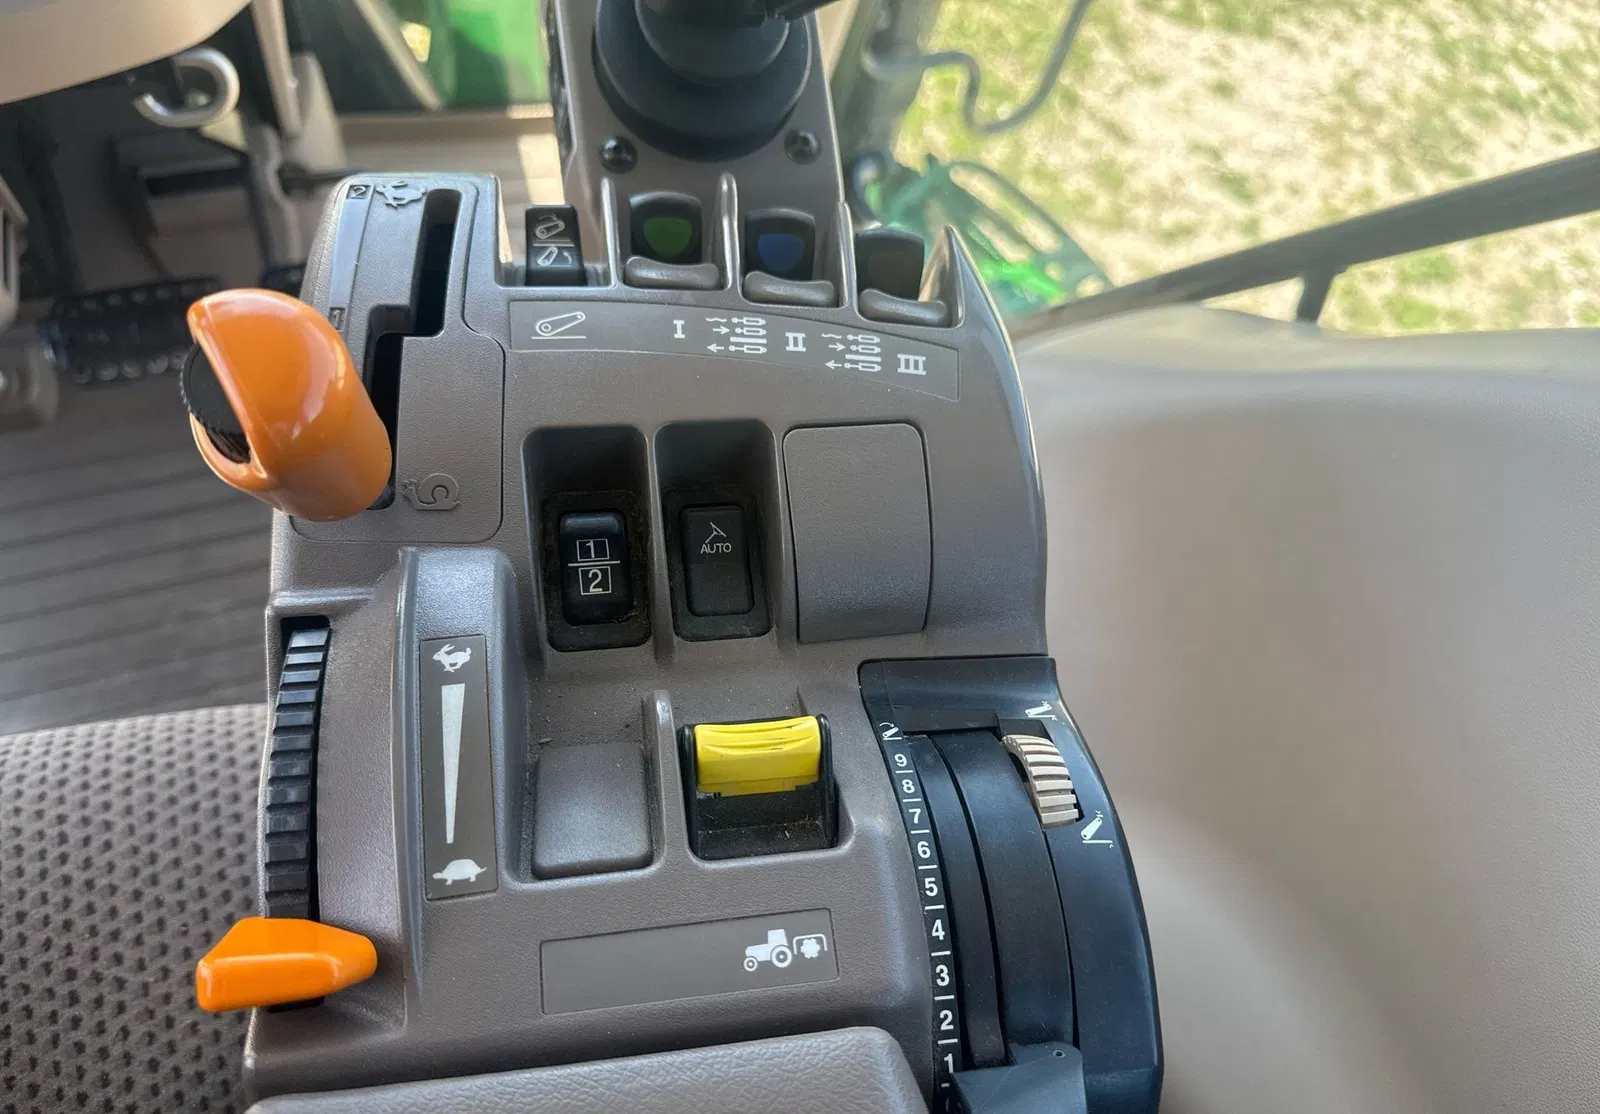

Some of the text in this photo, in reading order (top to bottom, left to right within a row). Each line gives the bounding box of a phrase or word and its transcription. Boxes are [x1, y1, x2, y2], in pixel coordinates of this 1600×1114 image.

[585, 540, 595, 558] 1
[700, 543, 732, 554] AUTO
[588, 568, 603, 593] 2
[894, 753, 907, 768] 9
[902, 779, 915, 793] 8
[909, 808, 921, 824] 7
[917, 840, 930, 859] 6
[925, 878, 938, 897] 5
[931, 919, 945, 940] 4
[936, 964, 950, 986] 3
[939, 1009, 954, 1031] 2
[943, 1053, 954, 1074] 1
